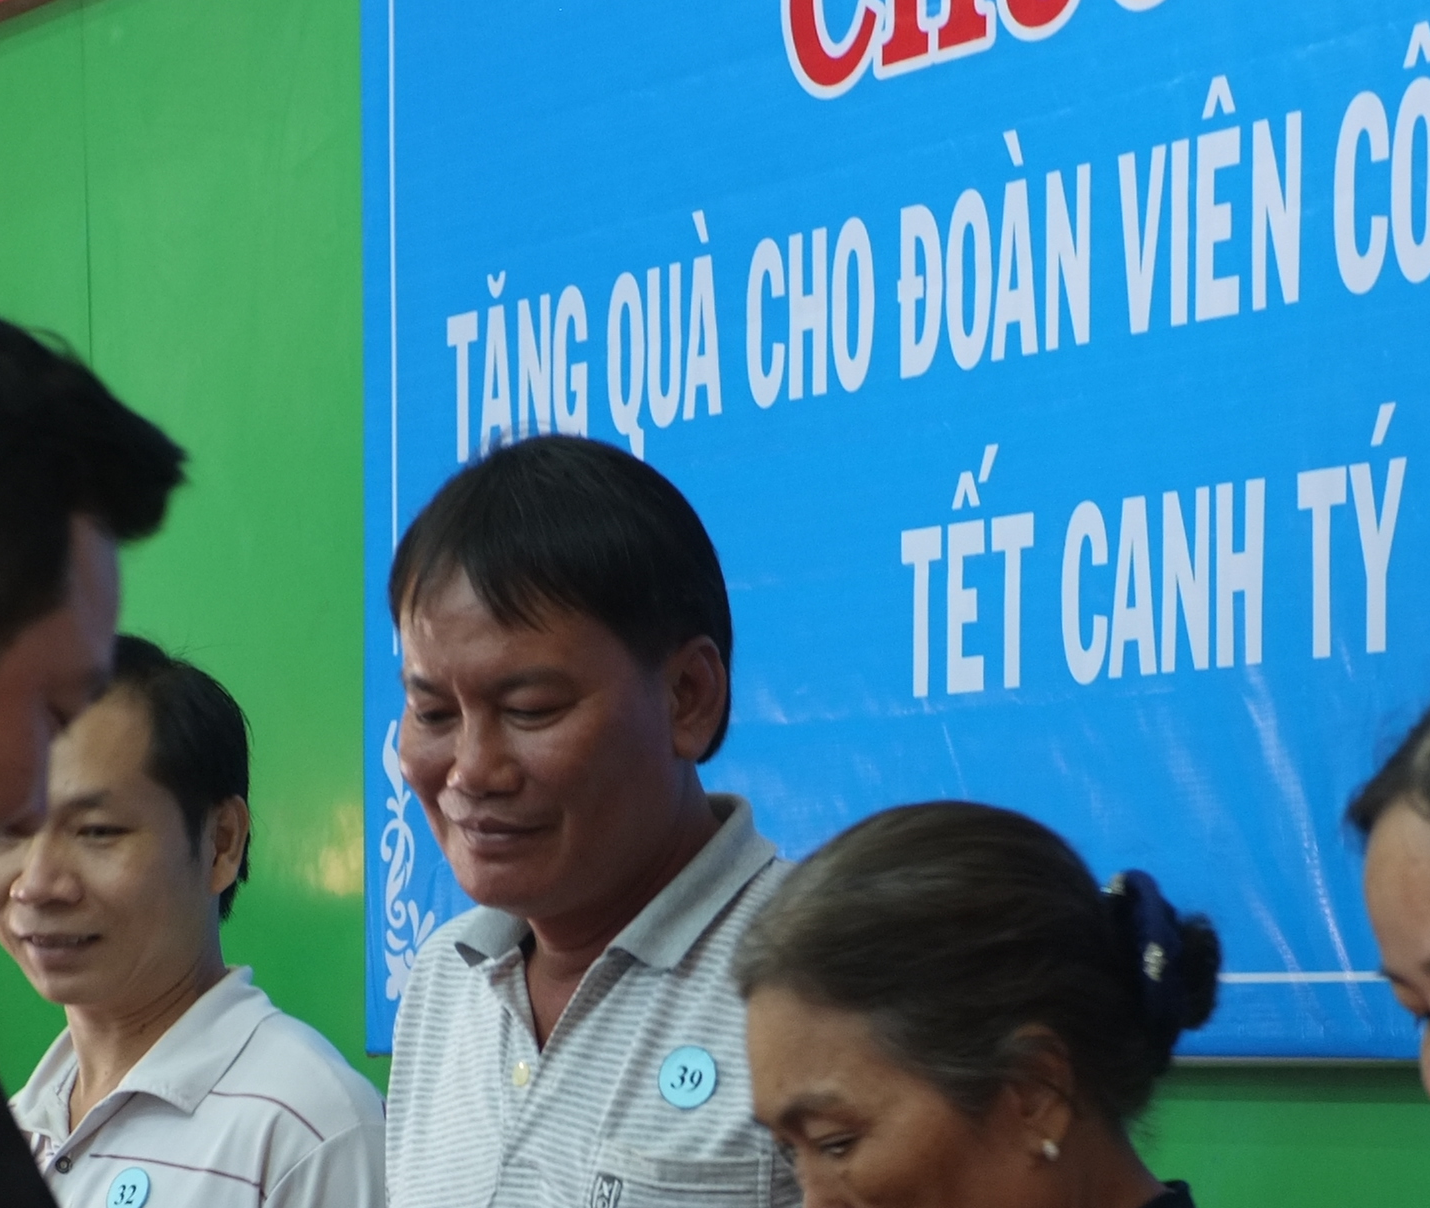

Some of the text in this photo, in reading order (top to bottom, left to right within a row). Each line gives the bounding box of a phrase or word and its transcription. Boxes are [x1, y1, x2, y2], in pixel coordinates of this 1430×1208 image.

[607, 210, 722, 462] QUÀ
[746, 217, 875, 408] CHO
[897, 130, 1091, 379] ĐOÀN
[1117, 75, 1303, 334] VIÊN
[900, 443, 1035, 698] TẾT
[1060, 478, 1267, 685] CANH
[1297, 402, 1408, 658] TÝ
[670, 1064, 704, 1092] 39
[113, 1184, 138, 1206] 32
